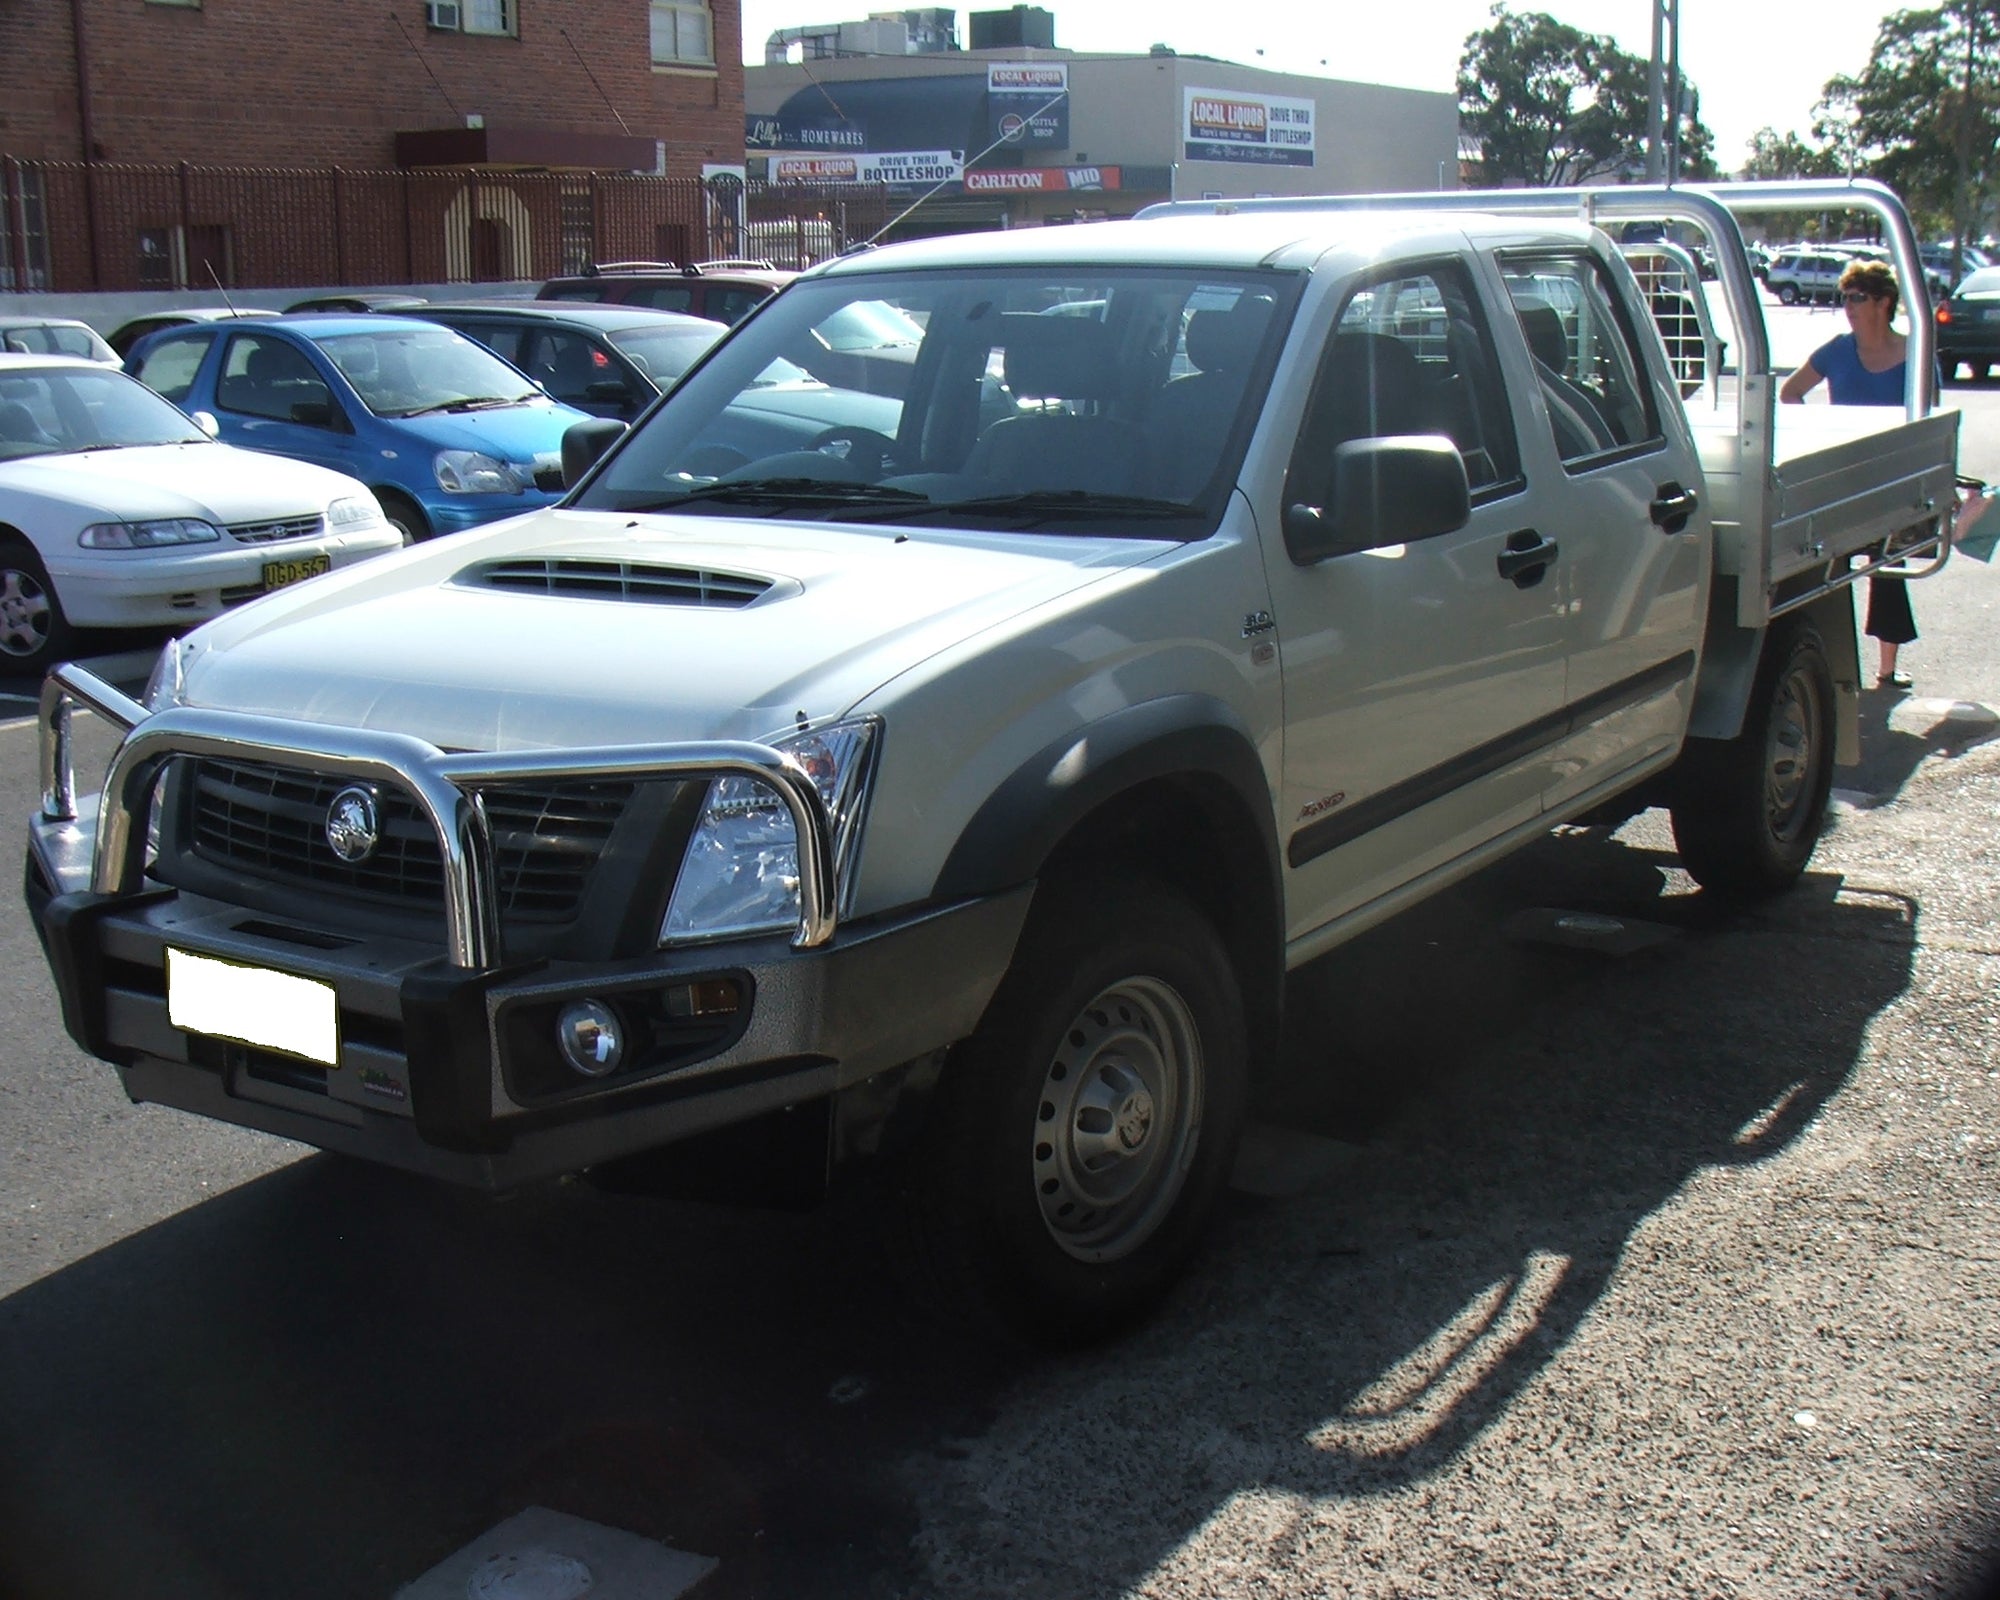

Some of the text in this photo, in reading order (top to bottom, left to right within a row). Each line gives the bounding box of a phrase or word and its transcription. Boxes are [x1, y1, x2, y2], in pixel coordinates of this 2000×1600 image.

[994, 71, 1022, 81] LOCAL
[1194, 102, 1225, 123] LOCAL
[1270, 107, 1310, 124] DRIVE THRU
[801, 129, 864, 145] HOMEWARES
[1270, 128, 1312, 145] BOTTLESHOP
[780, 161, 811, 174] LOCAL
[879, 155, 938, 167] DRIVE THRU
[864, 165, 954, 181] BOTTLESHOP
[967, 168, 1100, 189] CARLTON MID
